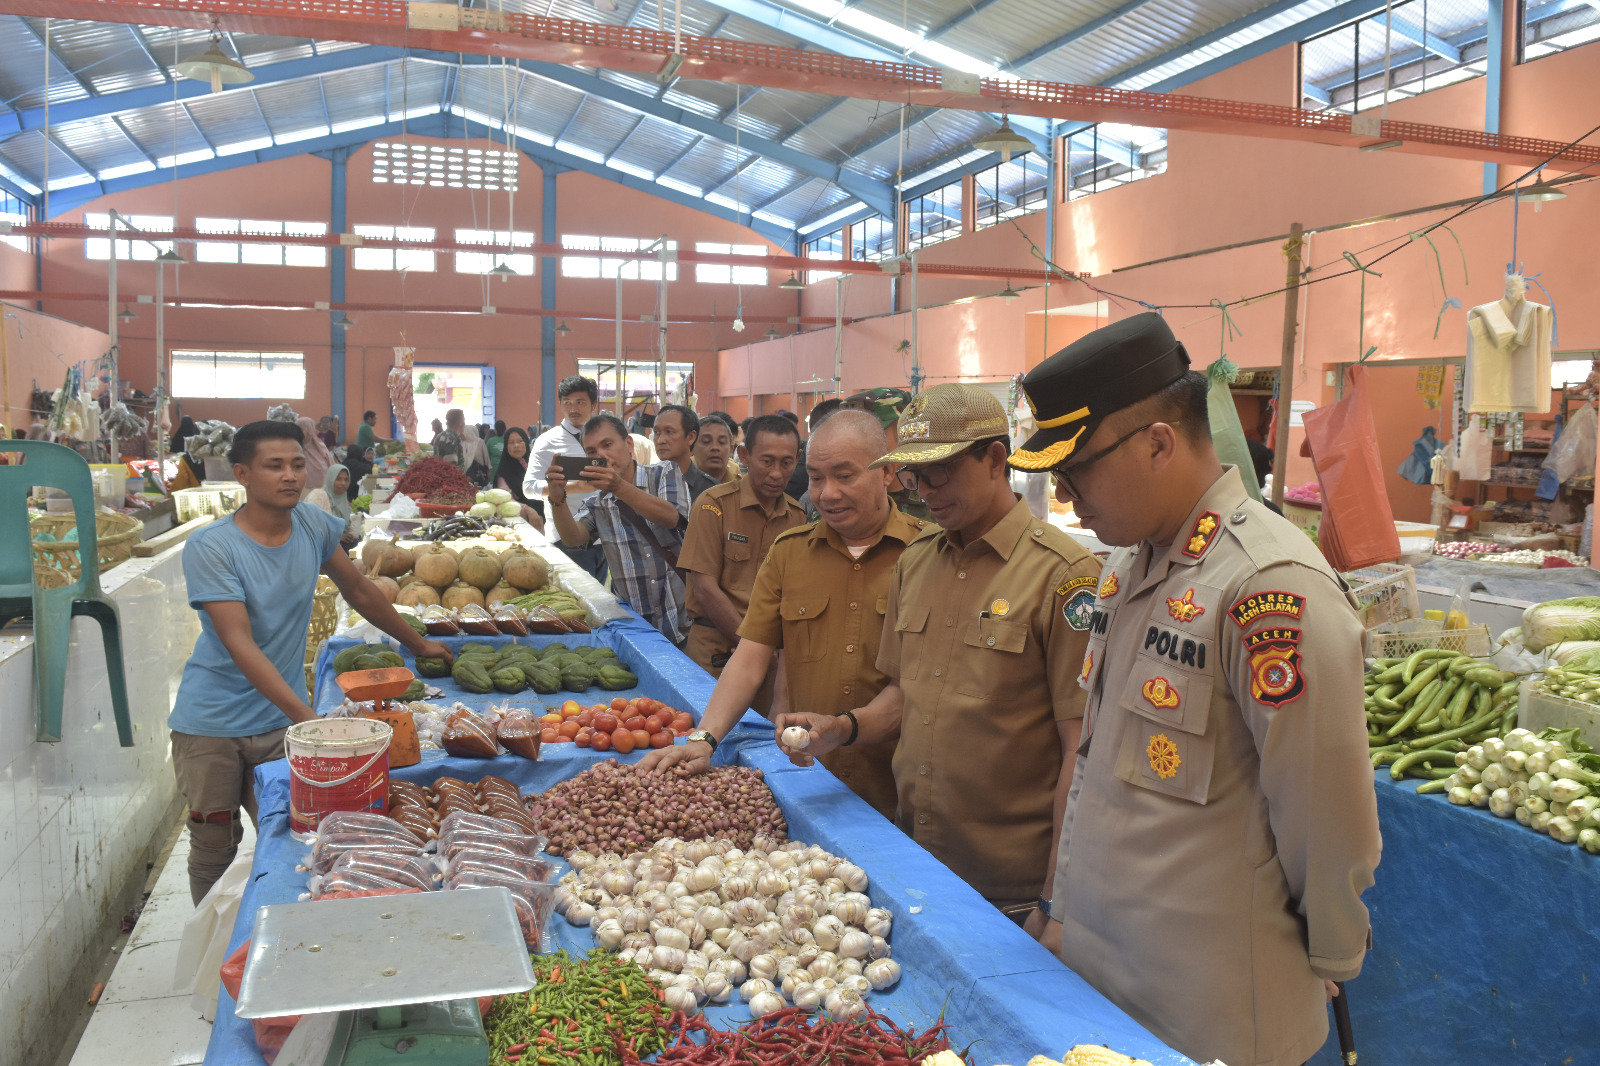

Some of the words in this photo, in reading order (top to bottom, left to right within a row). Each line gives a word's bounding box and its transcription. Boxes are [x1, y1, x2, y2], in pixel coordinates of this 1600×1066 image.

[1239, 594, 1294, 613] POLRES
[1239, 606, 1260, 625] ACEH
[1260, 602, 1299, 615] SELATAN
[1144, 625, 1206, 670] POLRI
[1252, 630, 1292, 644] ACEH
